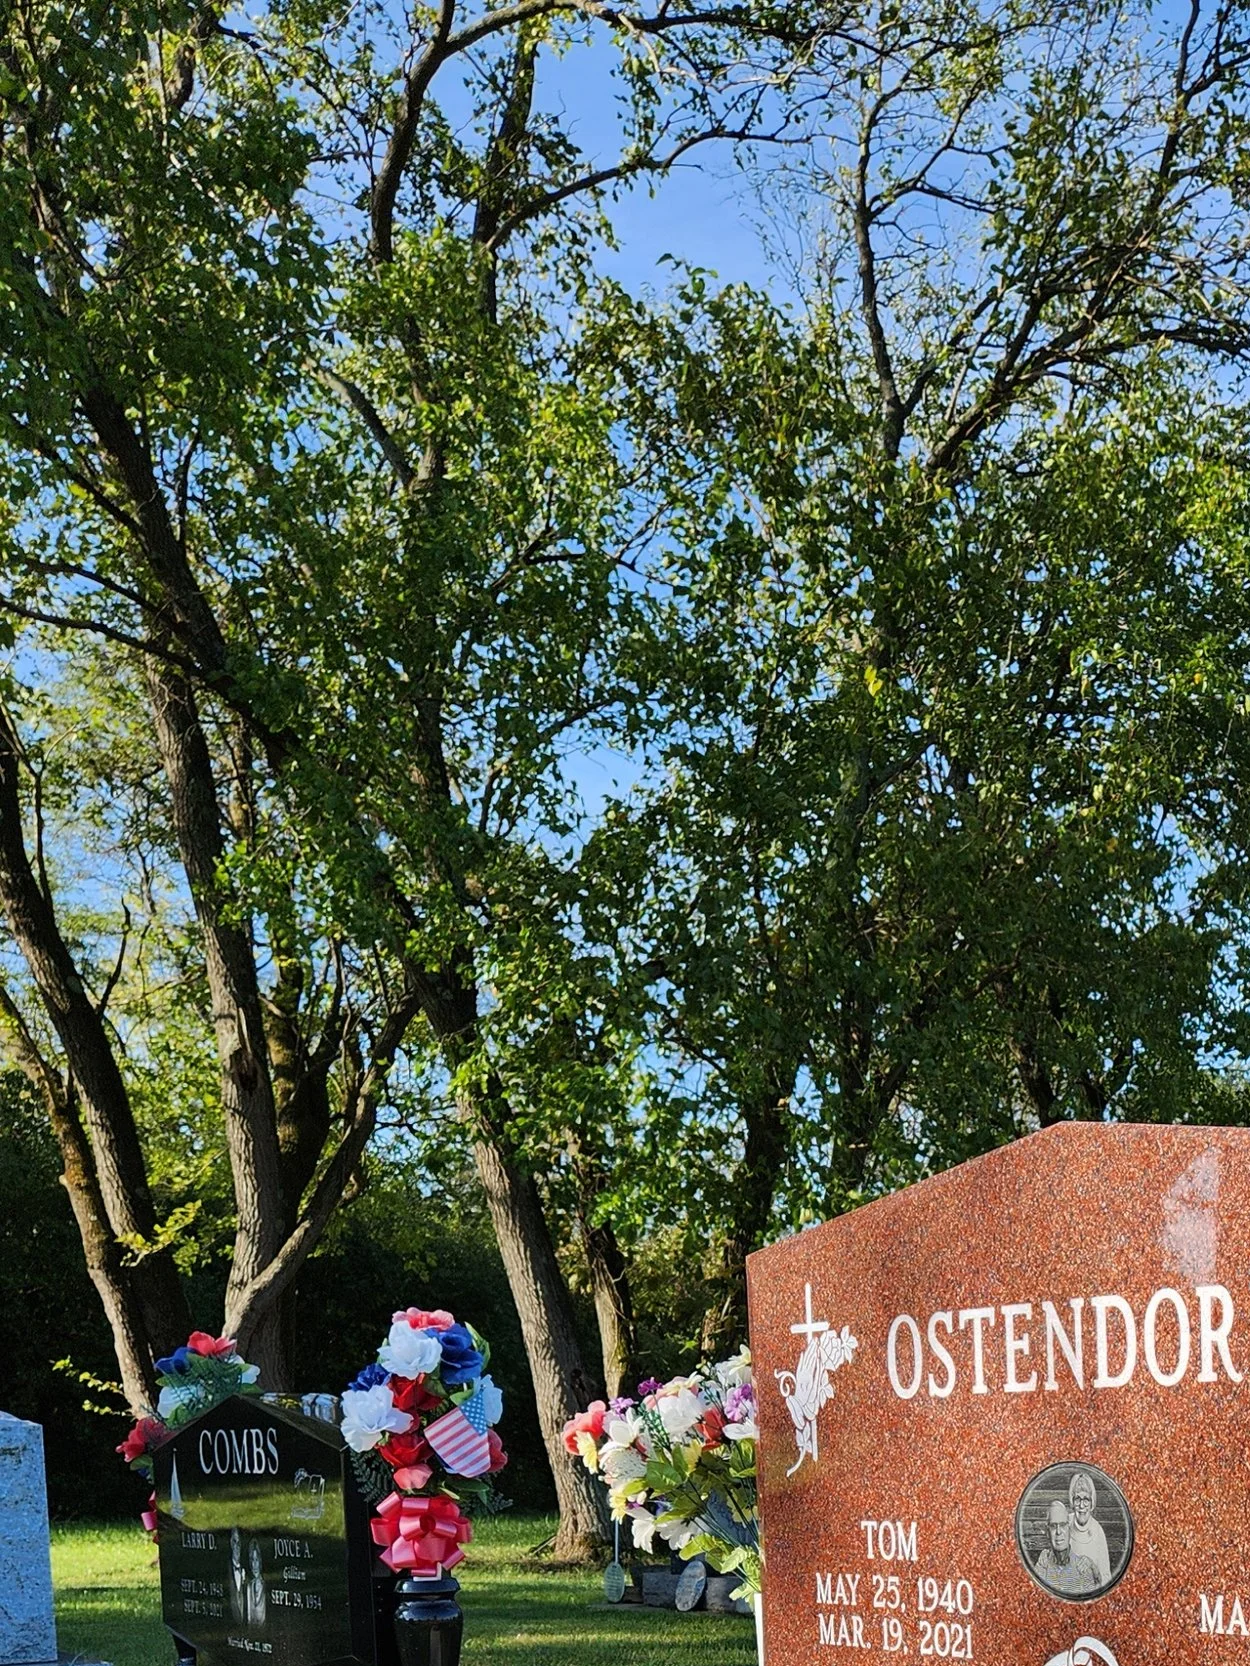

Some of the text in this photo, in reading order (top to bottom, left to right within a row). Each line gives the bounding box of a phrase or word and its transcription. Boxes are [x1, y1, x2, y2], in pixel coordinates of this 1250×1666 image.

[199, 1427, 279, 1475] COMBS
[181, 1531, 217, 1550] LARRY D.
[273, 1538, 314, 1559] JOYCE A.
[860, 1520, 918, 1561] TOM
[271, 1589, 291, 1606] SEPT.
[816, 1573, 974, 1615] MAY 25, 1940
[818, 1613, 974, 1659] MAR. 19, 2021
